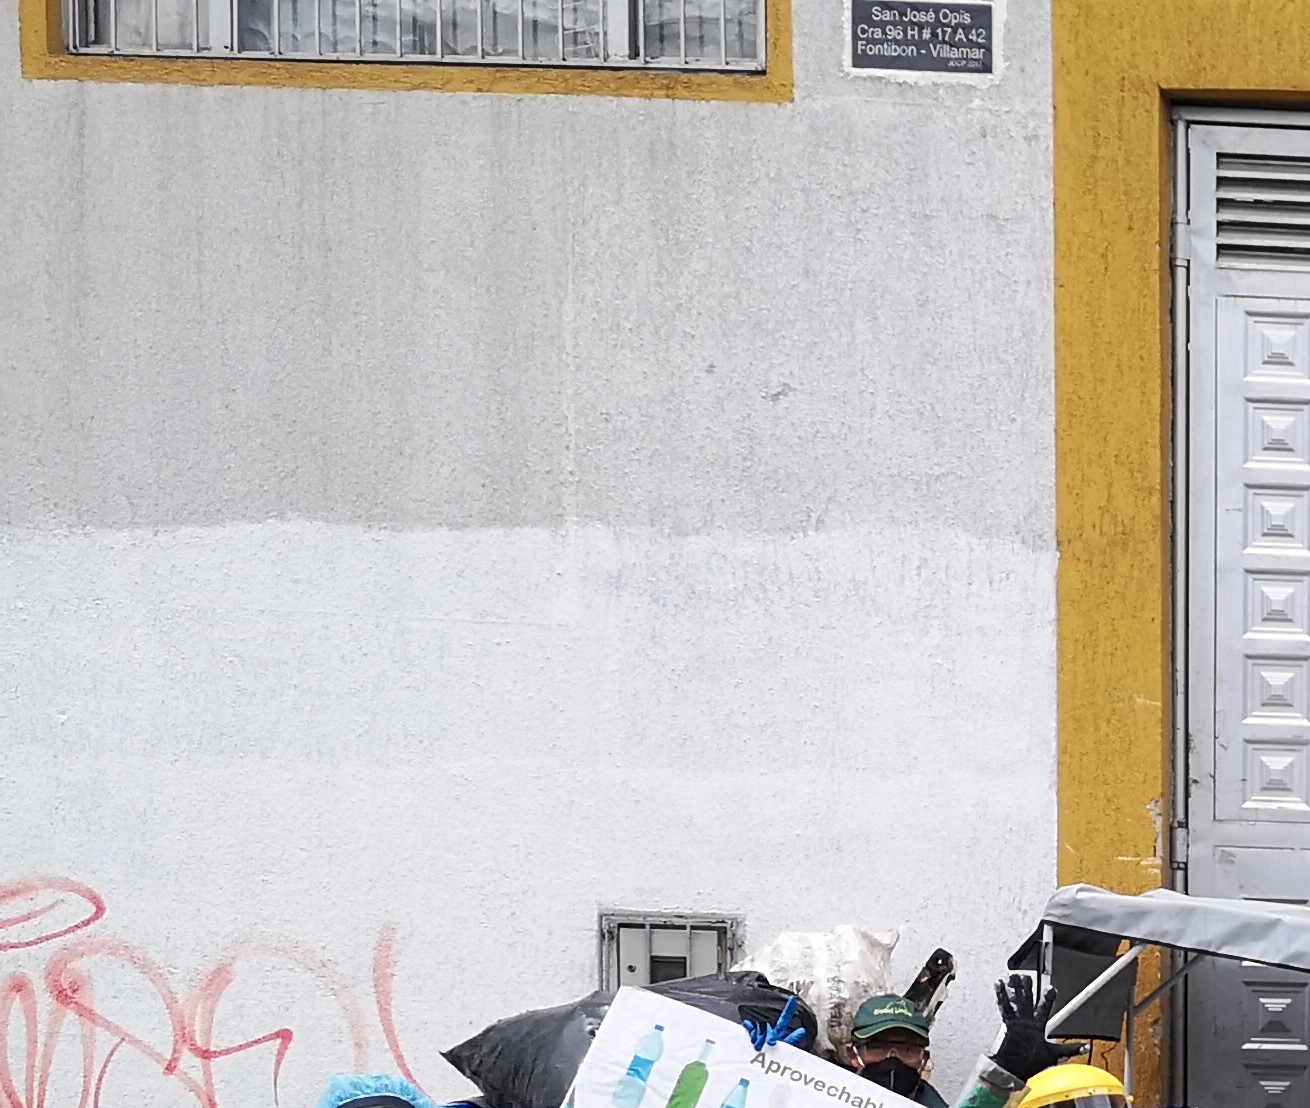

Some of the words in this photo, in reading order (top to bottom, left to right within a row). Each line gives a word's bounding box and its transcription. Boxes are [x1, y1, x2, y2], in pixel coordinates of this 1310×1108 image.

[872, 6, 899, 20] San
[903, 8, 935, 21] José
[939, 9, 972, 26] Opis
[857, 24, 903, 39] Cra.96
[907, 26, 918, 40] H
[922, 27, 931, 40] #
[936, 27, 952, 41] 17
[954, 28, 966, 42] A
[968, 28, 986, 42] 42
[857, 41, 917, 56] Fontibon
[929, 43, 985, 59] Villamar
